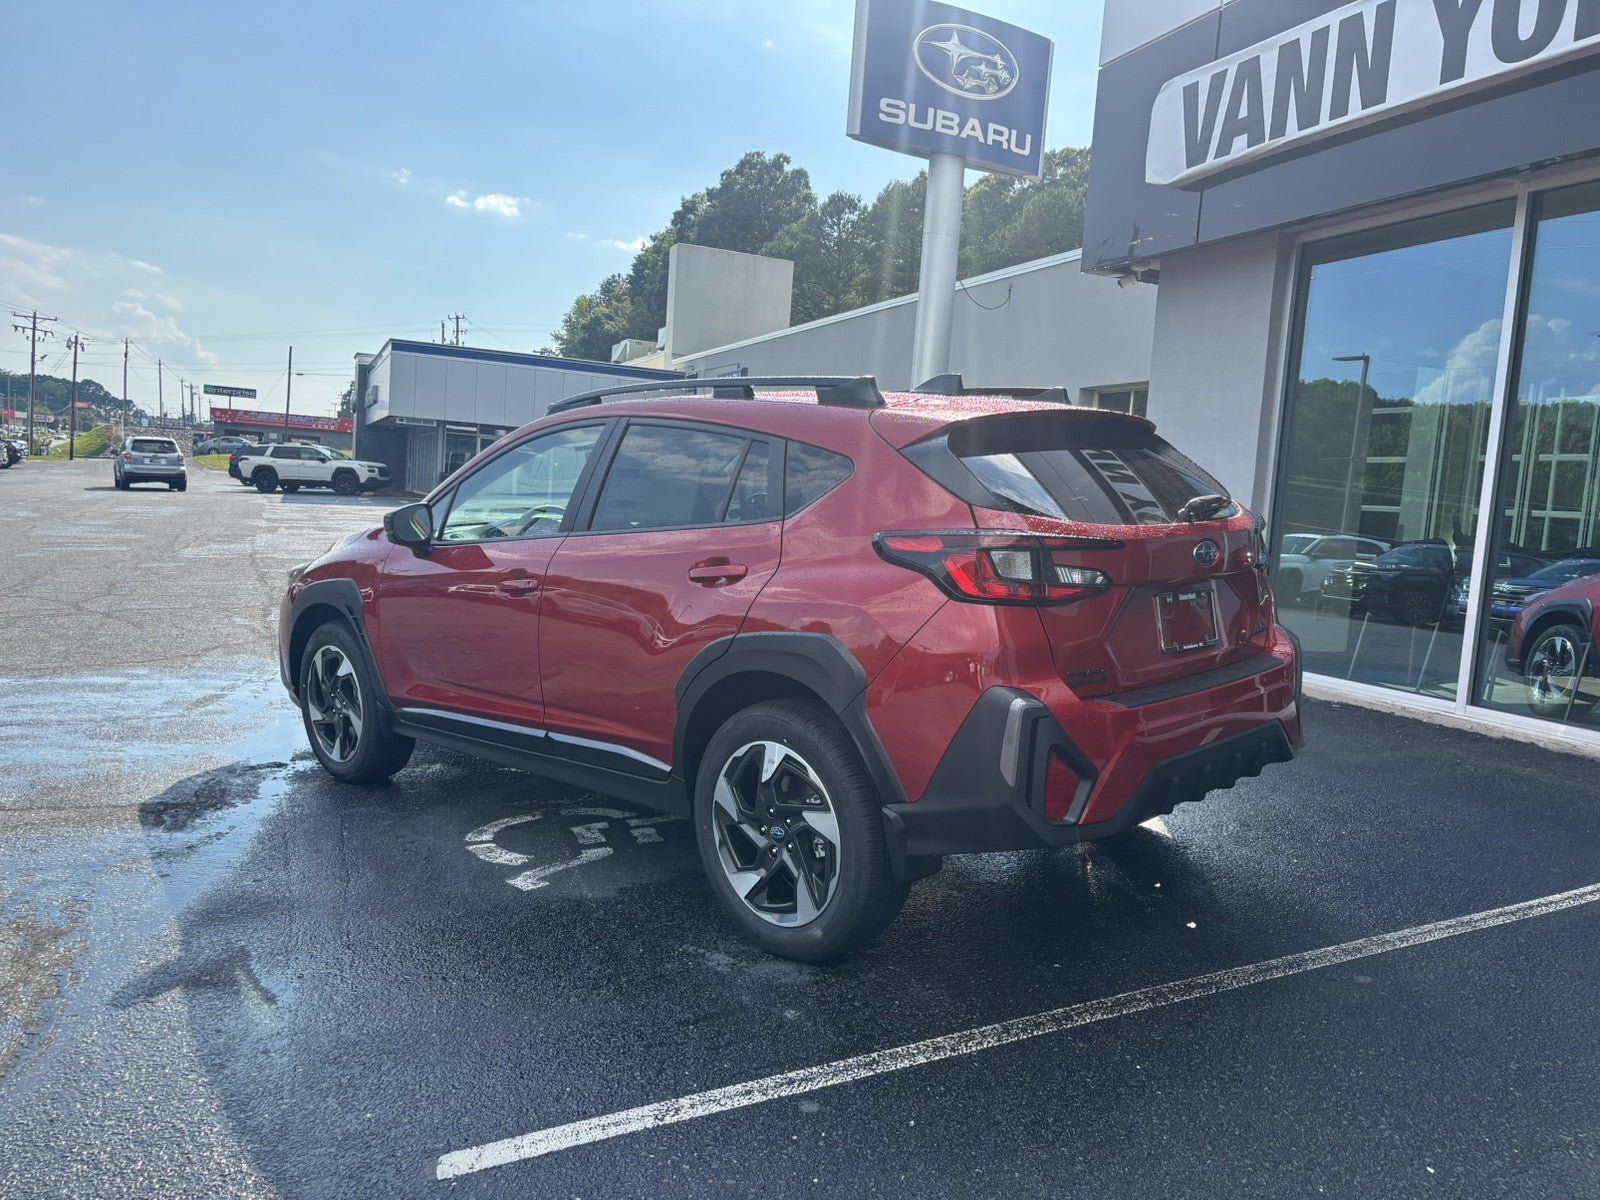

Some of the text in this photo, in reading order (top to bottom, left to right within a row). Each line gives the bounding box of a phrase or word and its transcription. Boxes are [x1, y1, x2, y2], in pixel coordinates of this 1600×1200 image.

[1182, 0, 1600, 170] VANN YO
[878, 97, 1032, 156] SUBARU
[206, 386, 256, 397] enterprise
